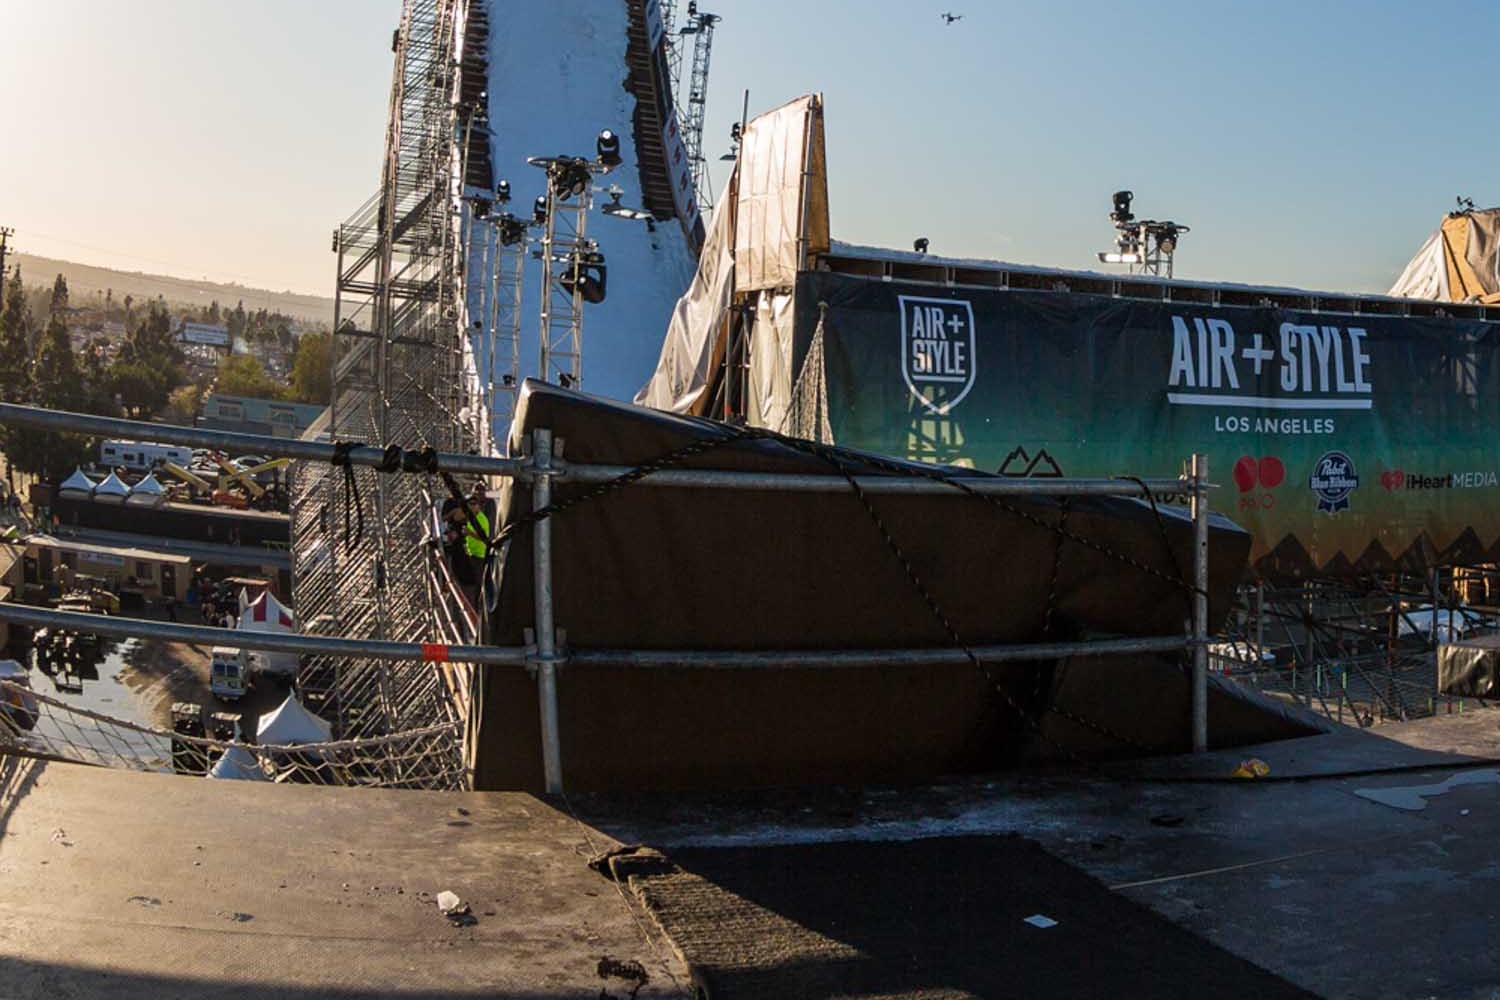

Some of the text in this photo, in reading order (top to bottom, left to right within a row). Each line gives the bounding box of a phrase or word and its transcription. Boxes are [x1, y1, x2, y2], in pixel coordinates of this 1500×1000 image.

[912, 339, 966, 374] STYLE
[1214, 415, 1335, 434] LOS ANGELES
[1407, 471, 1498, 489] iHeartMEDIA
